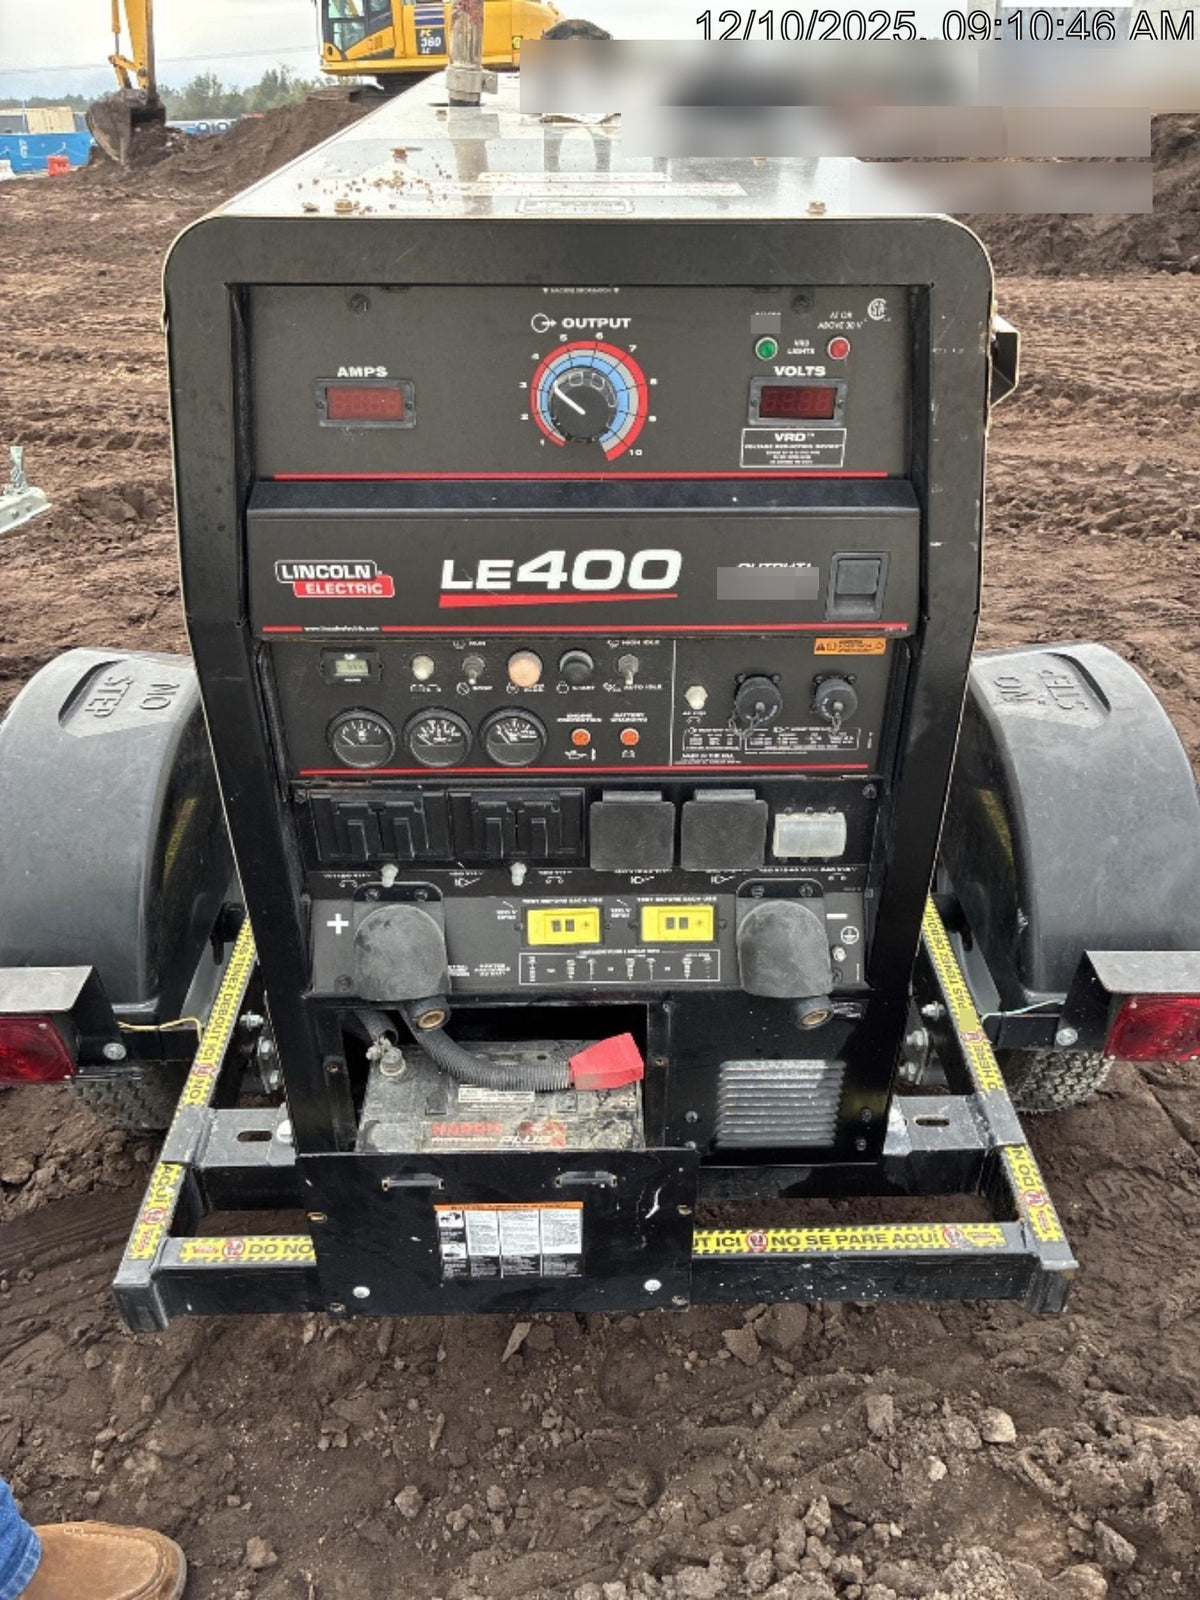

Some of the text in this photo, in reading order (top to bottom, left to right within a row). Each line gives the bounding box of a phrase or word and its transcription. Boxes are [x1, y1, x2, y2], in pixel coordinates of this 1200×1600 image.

[561, 317, 632, 329] OUTPUT
[629, 344, 637, 353] 7
[337, 366, 389, 378] AMPS
[774, 365, 826, 377] VOLTS
[281, 564, 370, 579] LINCOLN
[440, 549, 682, 590] LE400
[306, 583, 383, 595] ELECTRIC
[209, 993, 233, 1041] DEBOUT
[189, 1079, 205, 1100] NO
[1018, 1164, 1035, 1187] DO
[716, 1237, 741, 1247] ICI
[771, 1235, 801, 1247] NO
[805, 1235, 832, 1246] SE
[835, 1233, 889, 1245] PARE
[248, 1243, 278, 1254] DO
